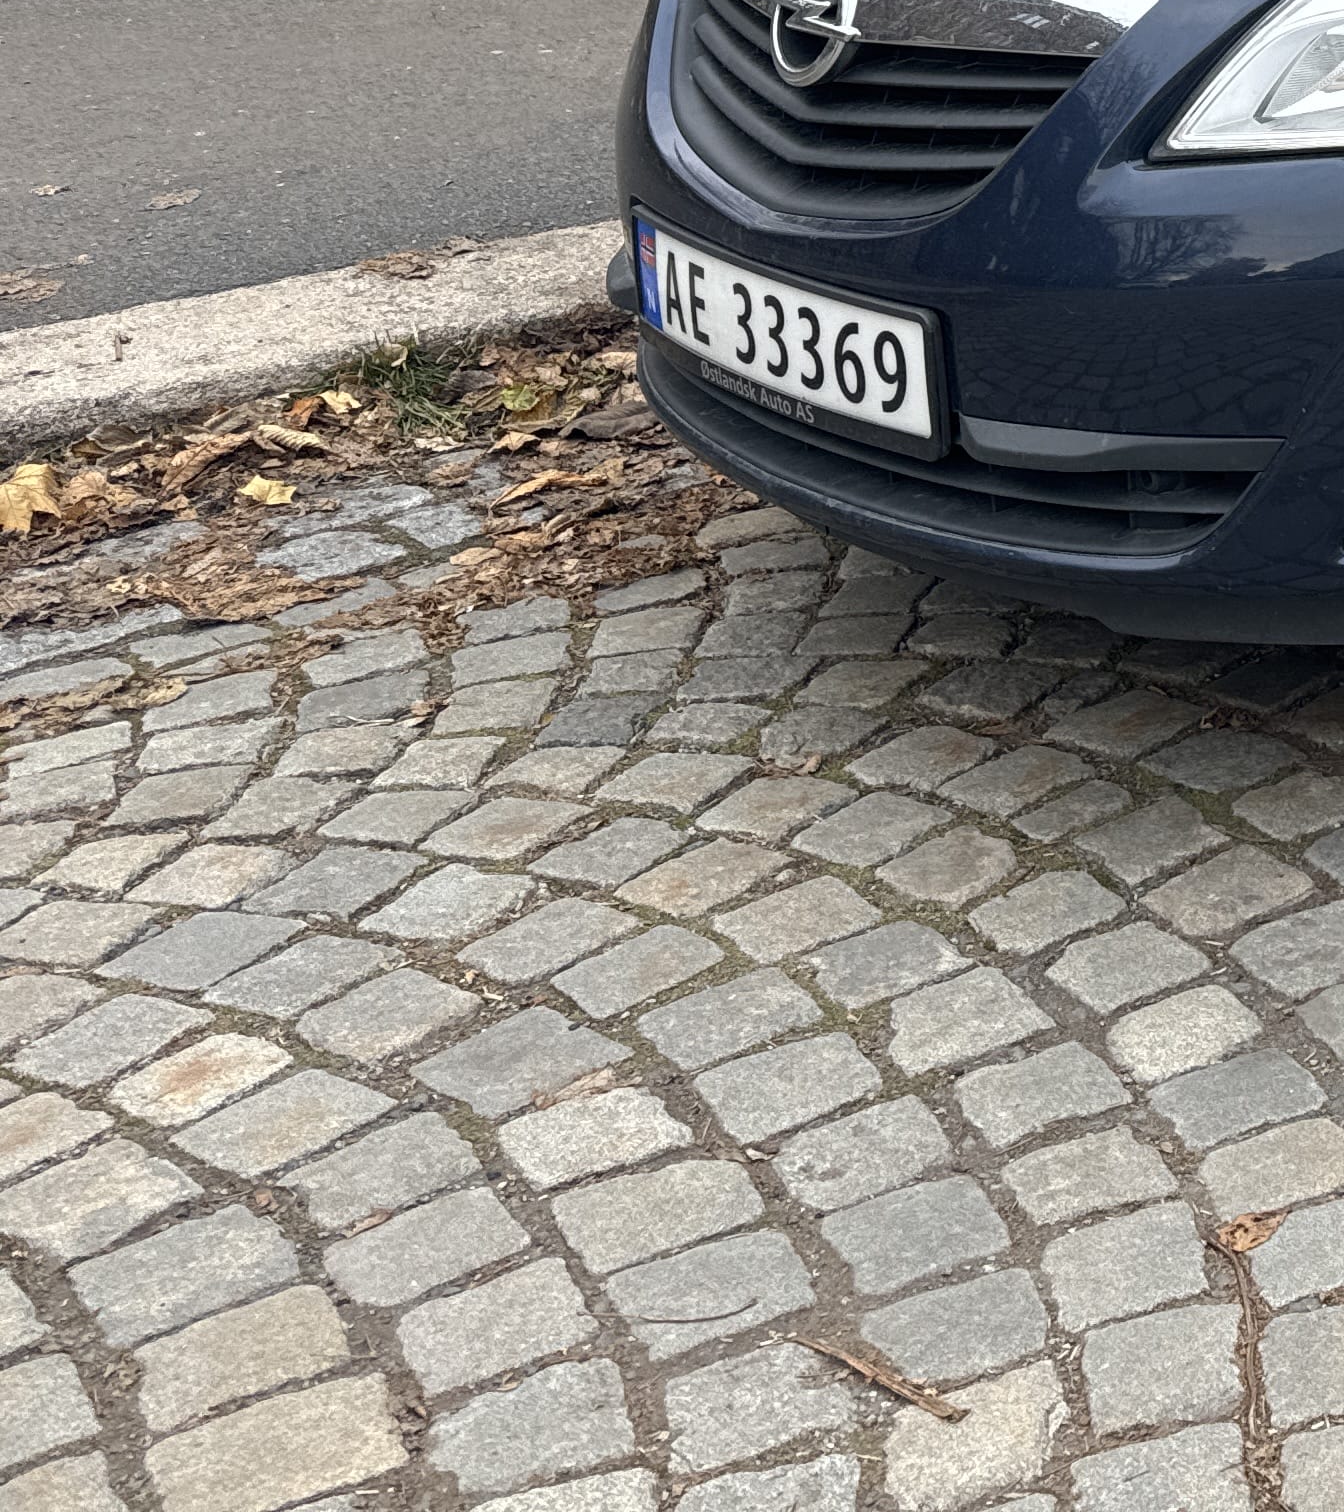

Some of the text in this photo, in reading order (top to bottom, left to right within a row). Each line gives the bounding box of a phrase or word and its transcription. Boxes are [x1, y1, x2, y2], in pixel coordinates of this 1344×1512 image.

[666, 251, 907, 413] AE 33369
[700, 360, 815, 424] Østlandsk Auto AS
